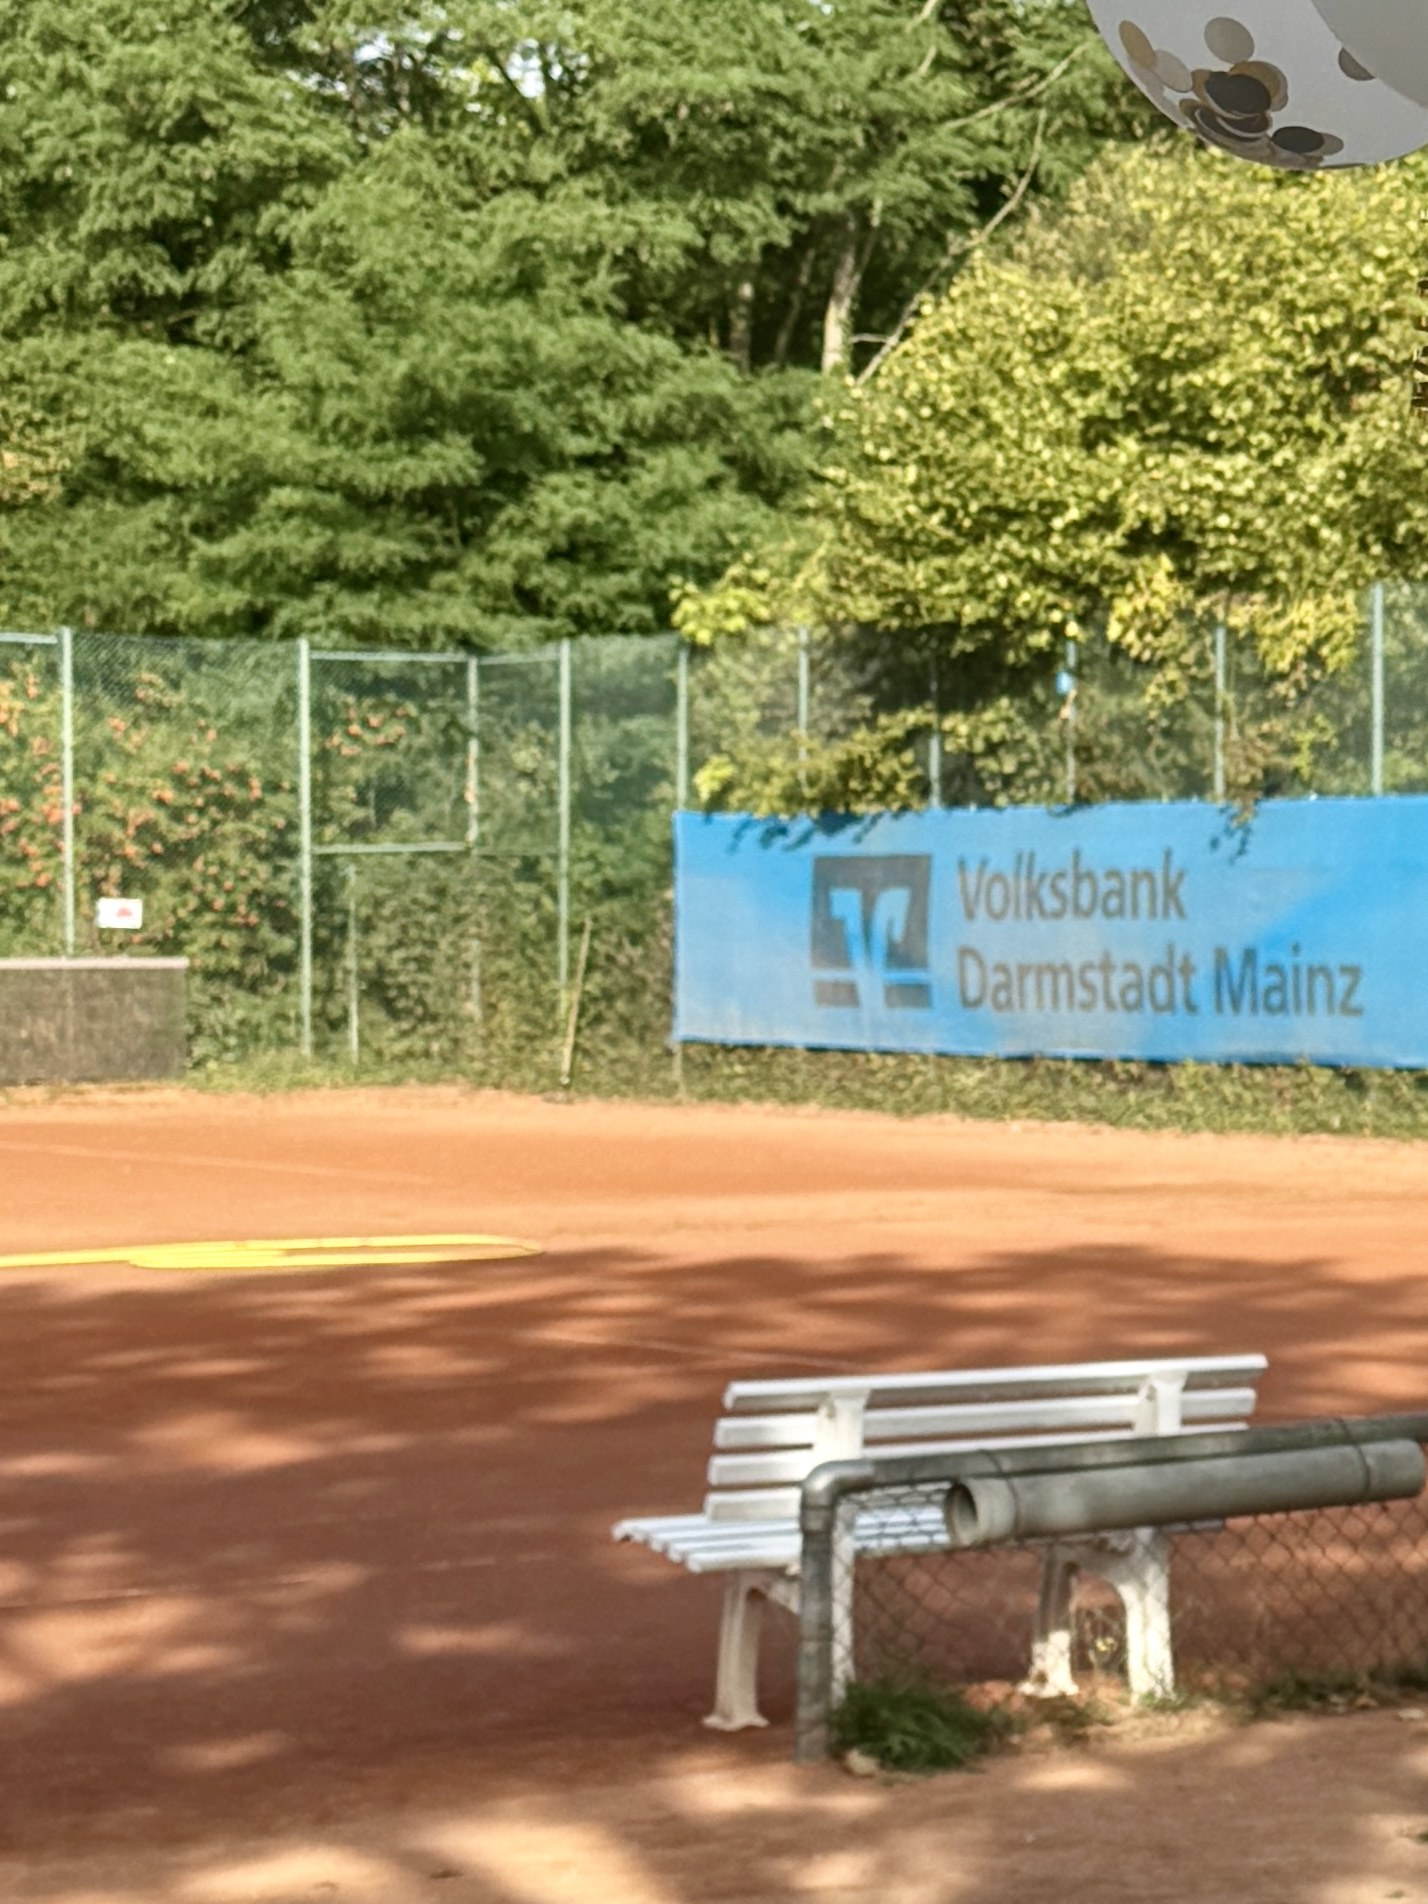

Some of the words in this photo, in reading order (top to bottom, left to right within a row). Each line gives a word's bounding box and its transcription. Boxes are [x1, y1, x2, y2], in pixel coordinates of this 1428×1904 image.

[957, 847, 1187, 921] Volksbank
[956, 942, 1198, 1015] Darmstadt
[1213, 940, 1363, 1017] Mainz
